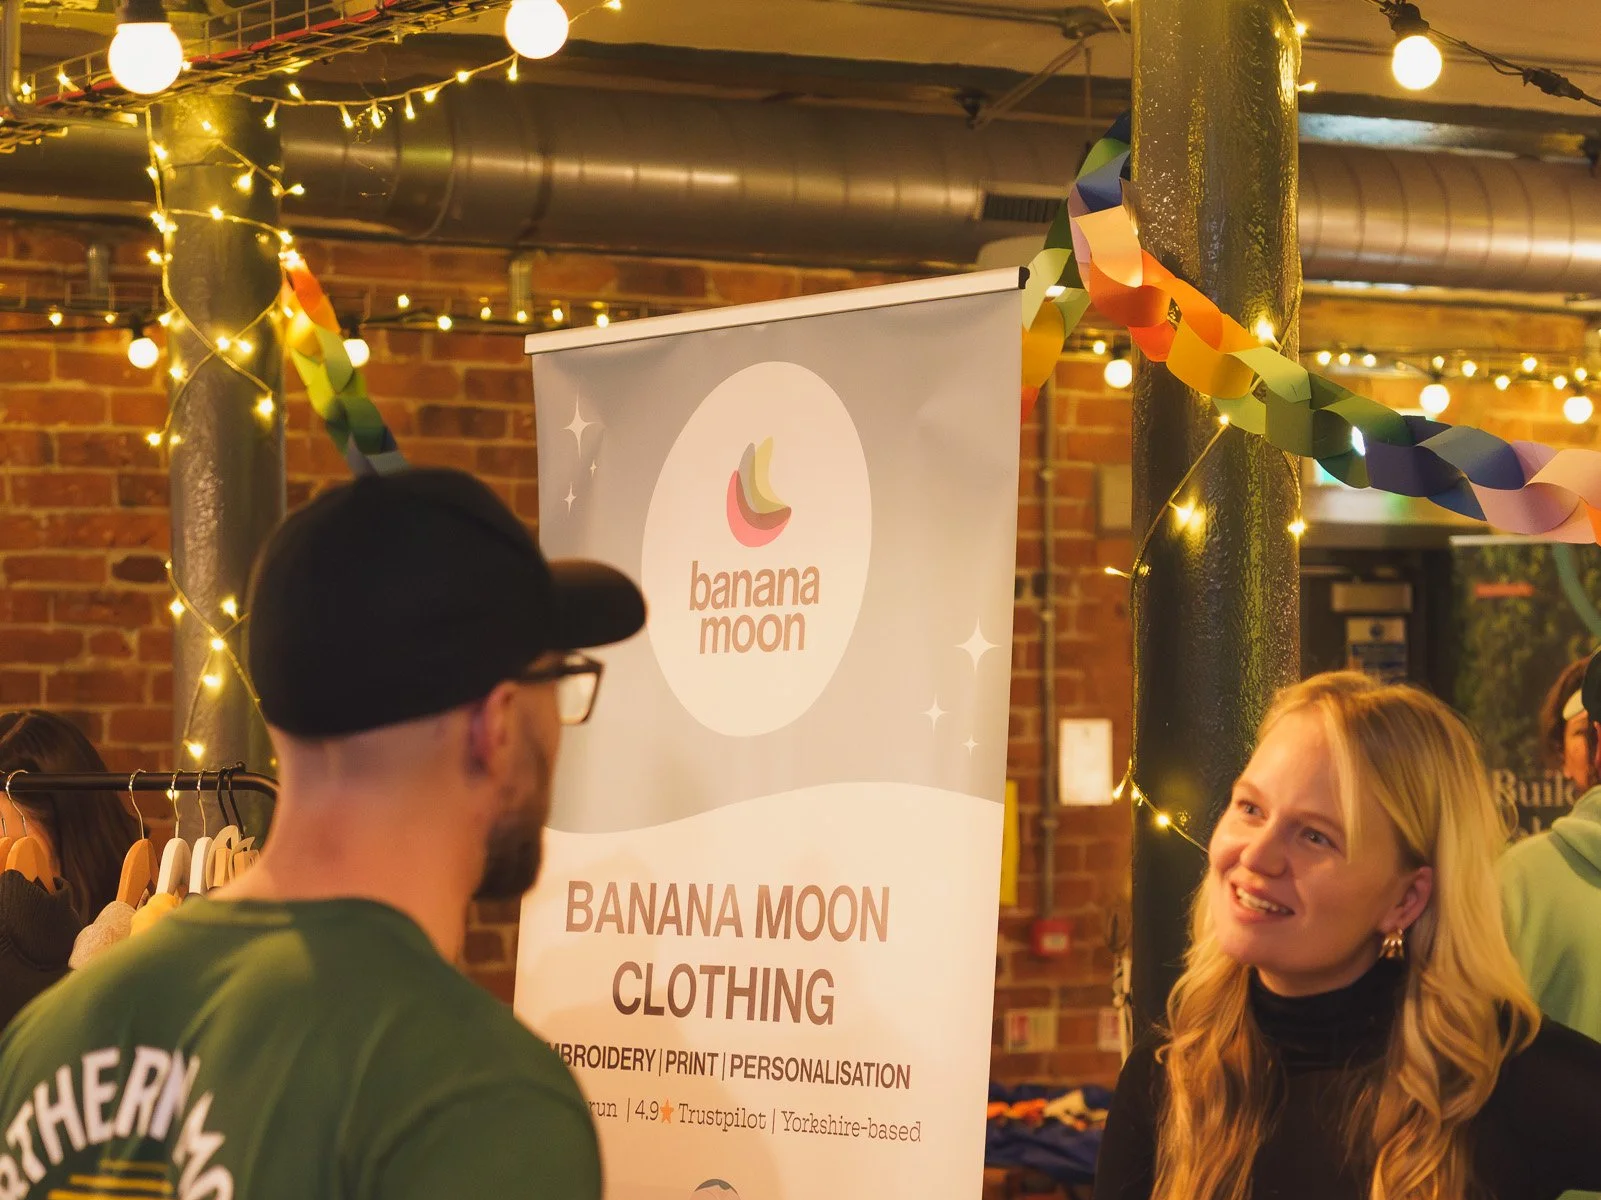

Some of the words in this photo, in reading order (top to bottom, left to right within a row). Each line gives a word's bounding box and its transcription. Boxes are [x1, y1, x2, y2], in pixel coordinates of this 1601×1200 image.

[689, 560, 820, 611] banana
[699, 612, 806, 654] moon
[566, 880, 744, 938] BANANA
[755, 884, 890, 942] MOON
[612, 961, 835, 1026] CLOTHING
[665, 1050, 719, 1076] PRINT
[730, 1053, 911, 1090] PERSONALISATION
[634, 1099, 660, 1121] 4.9
[678, 1103, 767, 1133] Trustpilot
[781, 1110, 922, 1143] Yorkshire-based
